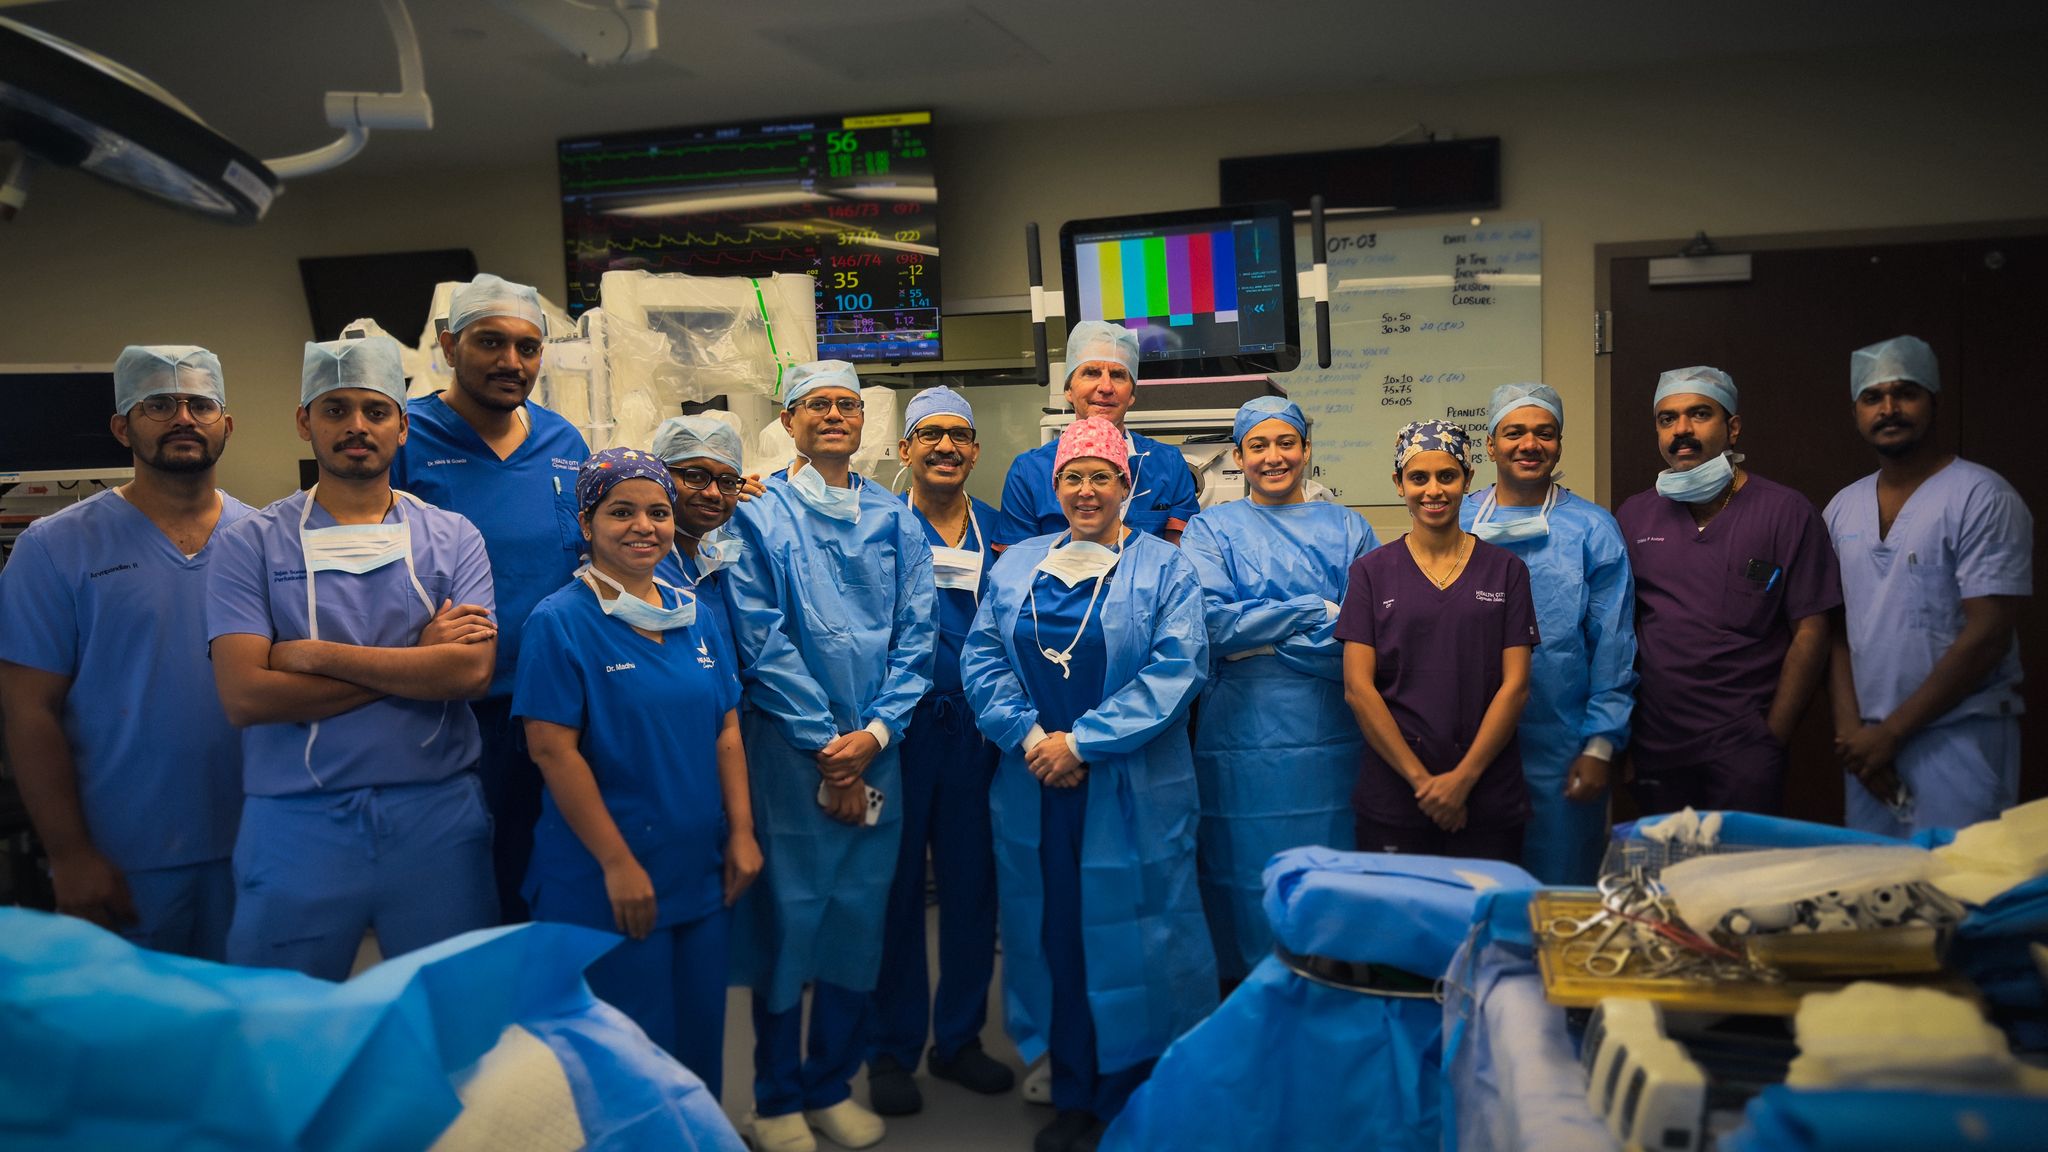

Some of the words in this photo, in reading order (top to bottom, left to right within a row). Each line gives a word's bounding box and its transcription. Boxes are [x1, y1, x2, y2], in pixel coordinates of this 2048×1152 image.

[827, 131, 858, 154] 56
[828, 203, 880, 217] 146/73
[894, 230, 920, 242] (22)
[831, 253, 881, 268] 146/74
[896, 253, 925, 264] (98)
[908, 264, 923, 275] 12
[833, 271, 859, 289] 35
[909, 275, 916, 286] 1
[909, 289, 922, 297] 55
[834, 293, 873, 311] 100
[1447, 407, 1488, 417] PEANUTS:
[885, 447, 890, 457] 4
[606, 665, 616, 673] Dr.
